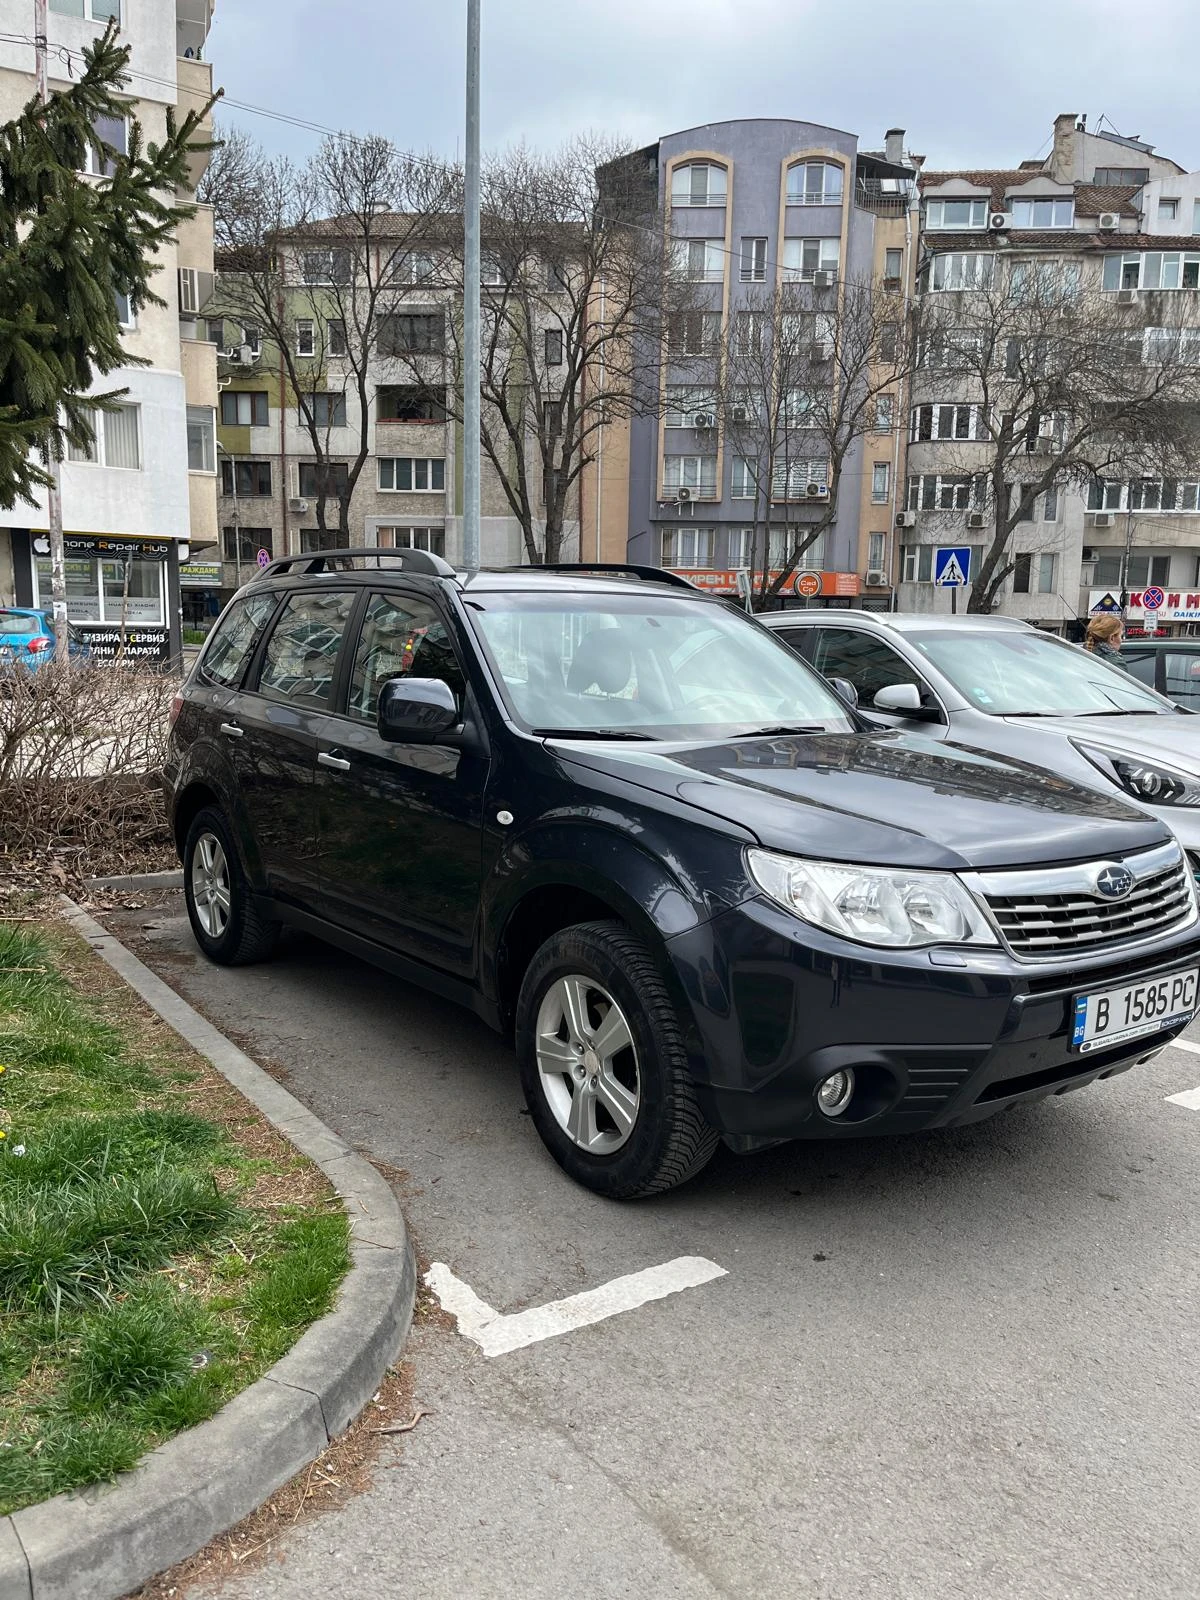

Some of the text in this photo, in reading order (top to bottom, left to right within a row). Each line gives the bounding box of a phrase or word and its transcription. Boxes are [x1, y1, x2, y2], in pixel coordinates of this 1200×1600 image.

[98, 541, 140, 551] Repair
[142, 544, 168, 552] Hub
[130, 634, 165, 643] СЕРВИЗ
[1095, 997, 1110, 1034] B
[1074, 1026, 1085, 1038] BG
